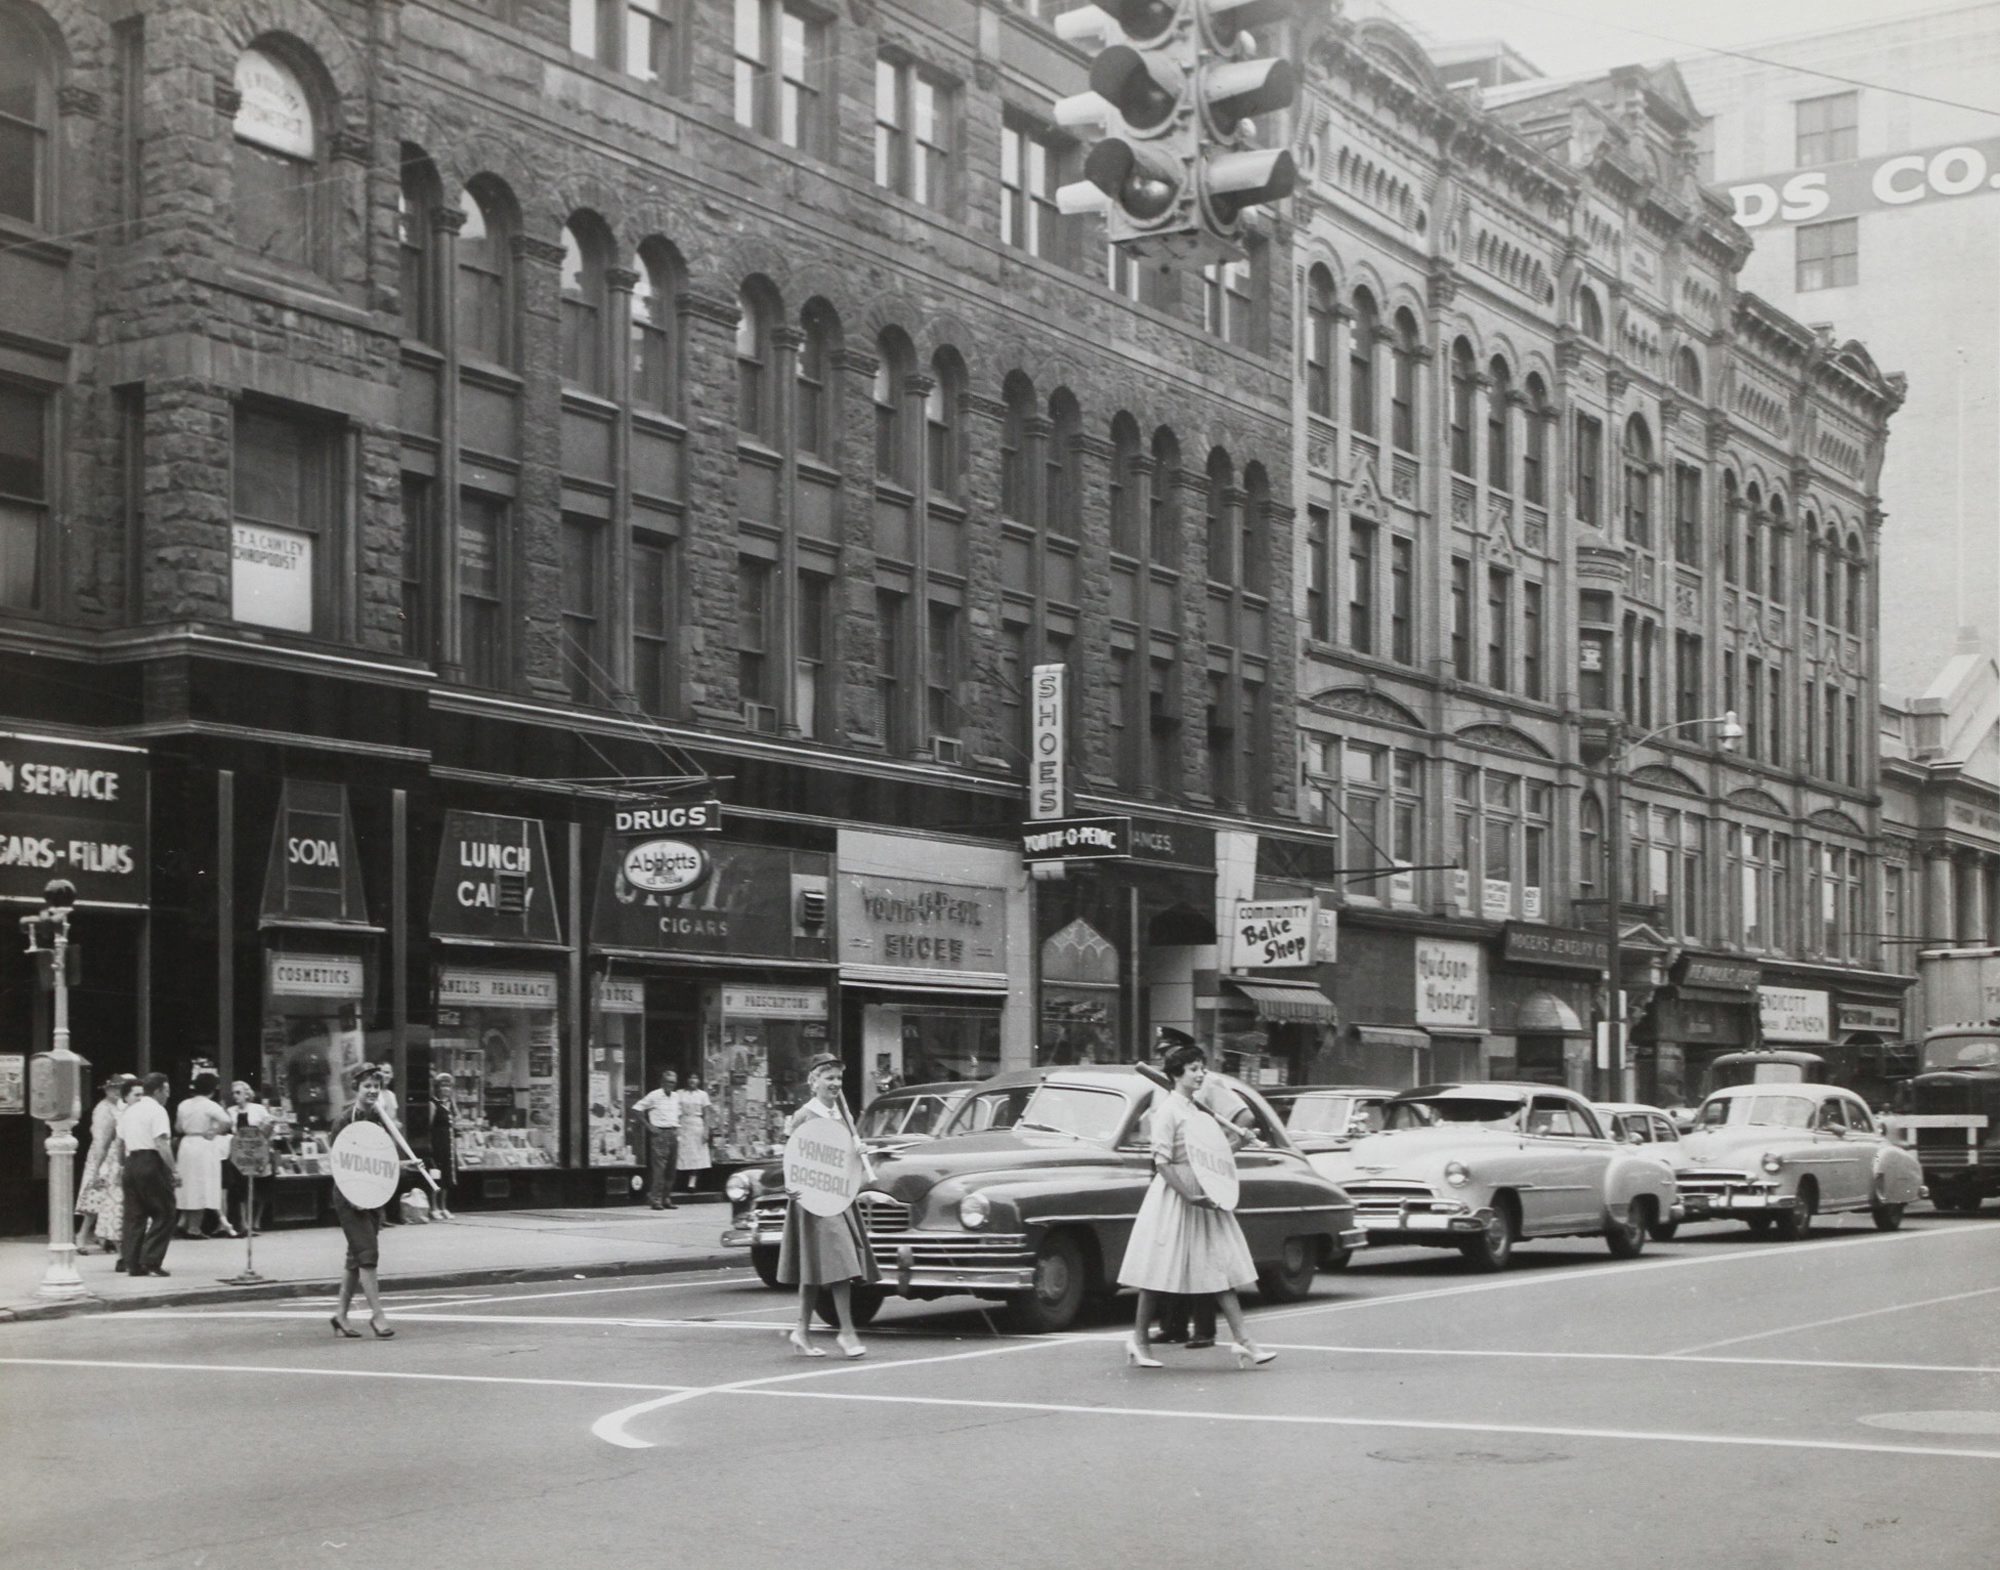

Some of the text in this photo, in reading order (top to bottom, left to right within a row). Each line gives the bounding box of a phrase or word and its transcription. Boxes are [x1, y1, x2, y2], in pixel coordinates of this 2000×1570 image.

[1728, 147, 2000, 227] DS CO.
[1038, 675, 1057, 813] SHOES
[20, 762, 119, 801] SERVICE
[615, 806, 706, 831] DRUGS
[288, 837, 341, 868] SODA
[460, 841, 531, 872] LUNCH
[629, 852, 697, 872] Abbotts
[457, 880, 534, 911] CAY
[659, 916, 729, 936] CIGARS
[1241, 919, 1292, 947] Bake
[885, 933, 963, 963] SHOES
[1263, 936, 1306, 964] Shop
[1511, 932, 1550, 952] ROGERS
[277, 966, 351, 985] COSMETICS
[1418, 949, 1469, 980] Hudson
[491, 981, 551, 997] PHARMACY
[601, 987, 634, 1002] RUGS
[1425, 983, 1476, 1021] Hosiery
[1760, 993, 1807, 1012] ENDICOTT
[1784, 1015, 1825, 1033] JOHNSON
[798, 1137, 846, 1168] YANKEE
[790, 1164, 851, 1198] BASEBALL
